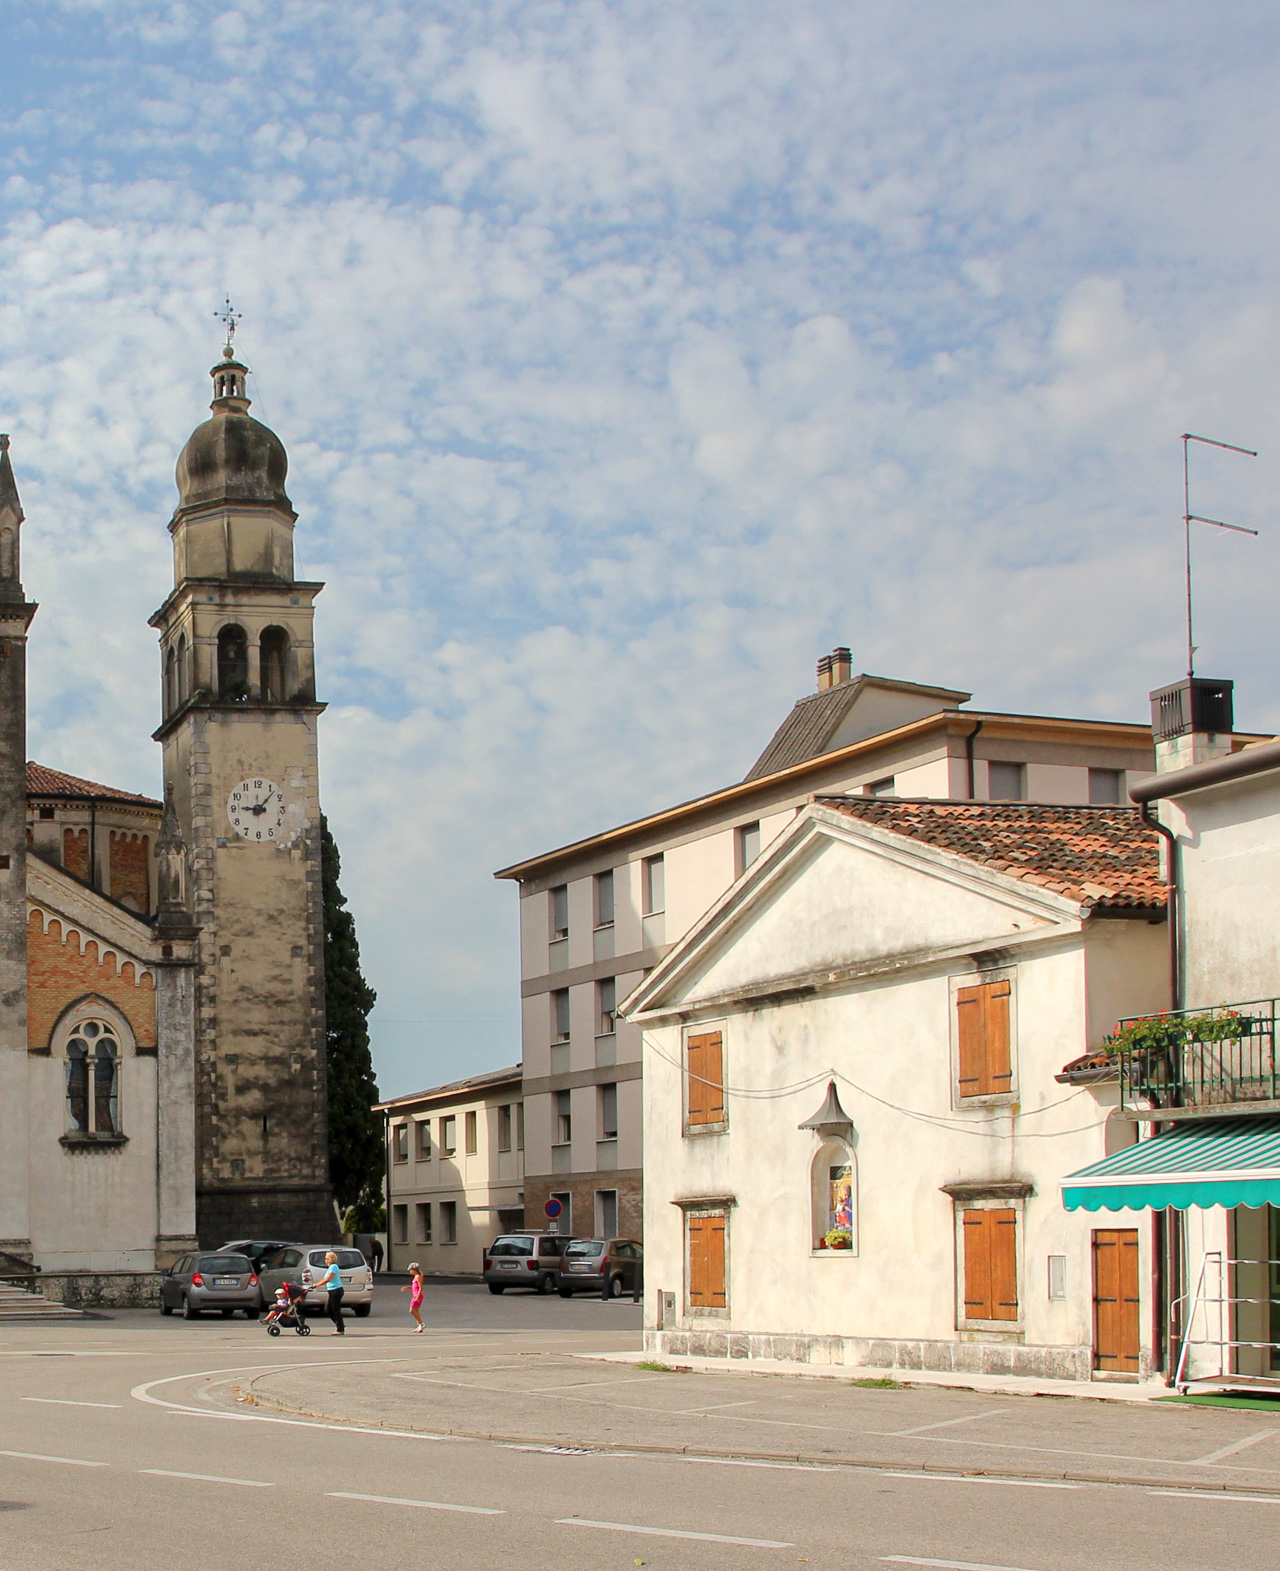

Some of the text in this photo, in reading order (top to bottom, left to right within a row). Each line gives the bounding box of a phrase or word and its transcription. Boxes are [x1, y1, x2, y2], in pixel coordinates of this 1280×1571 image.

[242, 783, 249, 792] 11
[254, 780, 263, 789] 12
[268, 784, 272, 793] 1
[233, 792, 242, 801] 10
[276, 793, 283, 802] 2
[230, 804, 237, 813] 9
[279, 805, 286, 815] 3
[234, 817, 240, 826] 8
[275, 818, 282, 827] 4
[243, 827, 249, 836] 7
[255, 830, 262, 840] 6
[268, 828, 274, 837] 5
